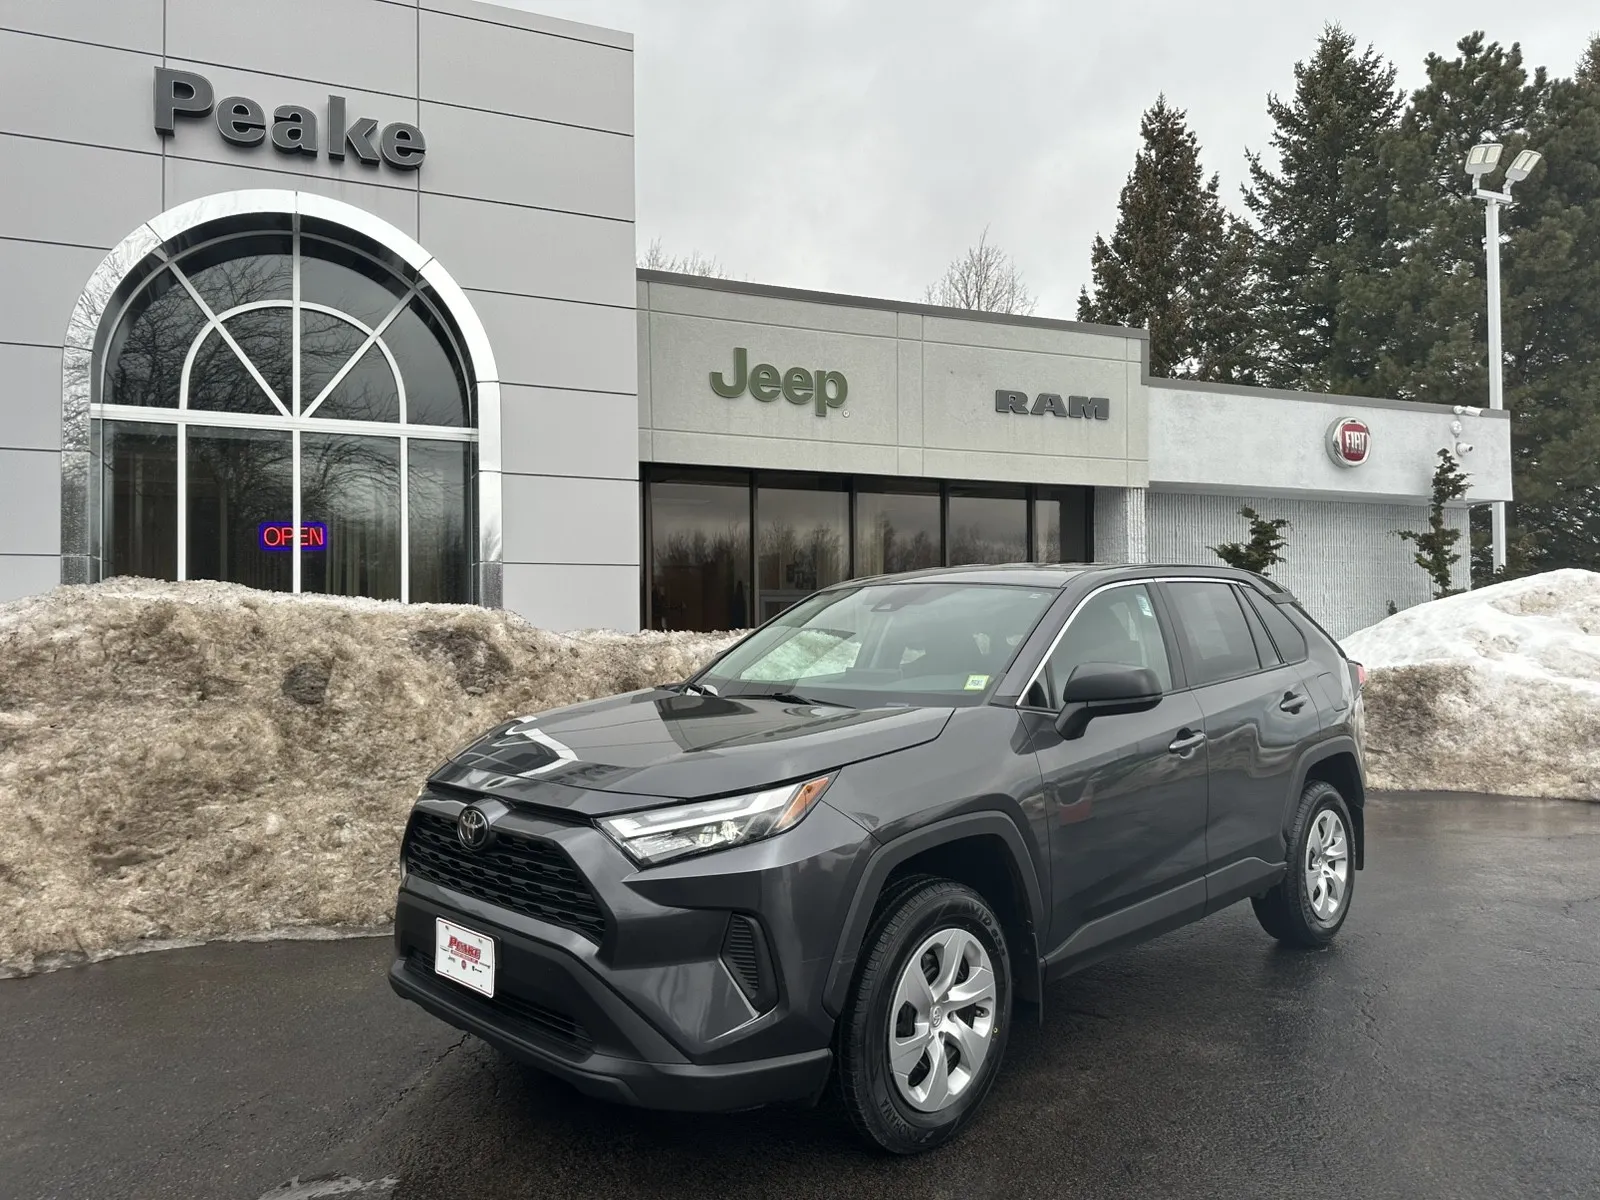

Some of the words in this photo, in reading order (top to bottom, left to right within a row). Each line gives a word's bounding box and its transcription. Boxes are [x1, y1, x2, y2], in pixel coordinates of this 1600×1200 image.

[153, 66, 426, 172] Peake
[709, 347, 848, 417] Jeep
[995, 389, 1110, 420] RAM
[1344, 430, 1366, 451] FIAT
[263, 526, 324, 546] OPEN
[880, 1096, 922, 1140] KOHAMA
